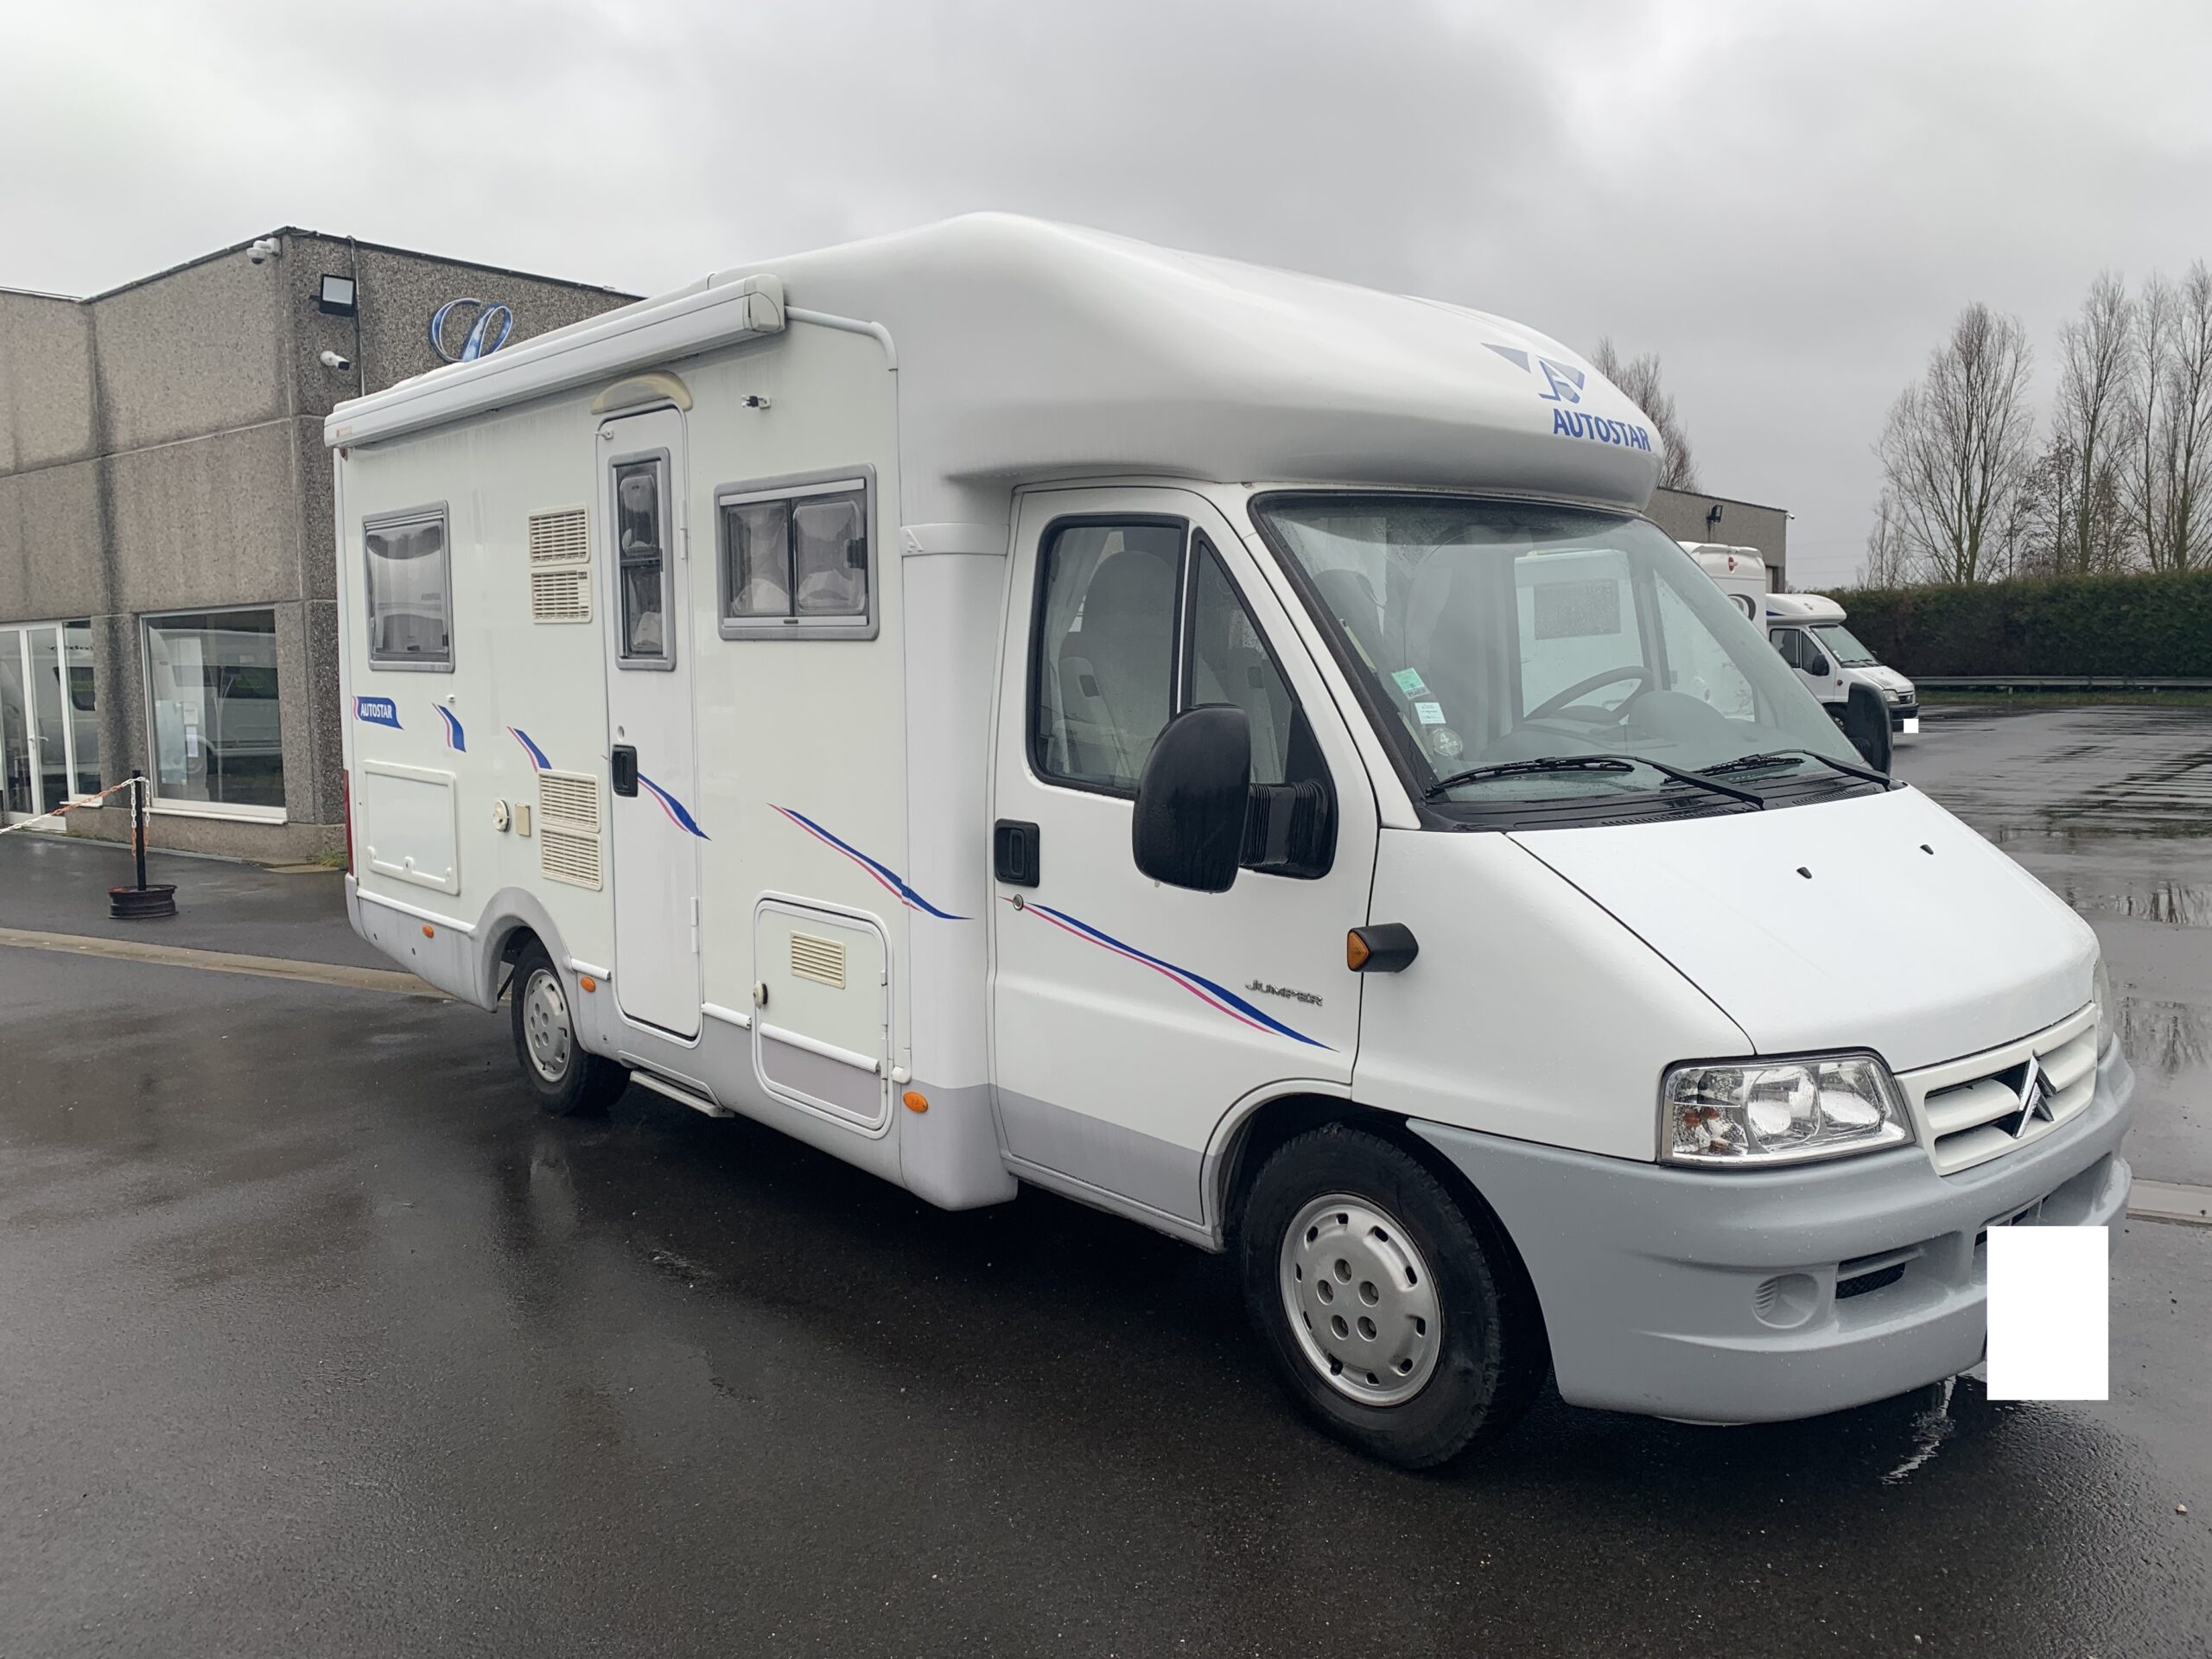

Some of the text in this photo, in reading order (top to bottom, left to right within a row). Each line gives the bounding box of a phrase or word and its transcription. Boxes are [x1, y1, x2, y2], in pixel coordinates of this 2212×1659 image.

[1553, 408, 1652, 452] AUTOSTAR
[360, 702, 392, 719] AUTOSTAR
[1245, 978, 1324, 1007] JUMPER
